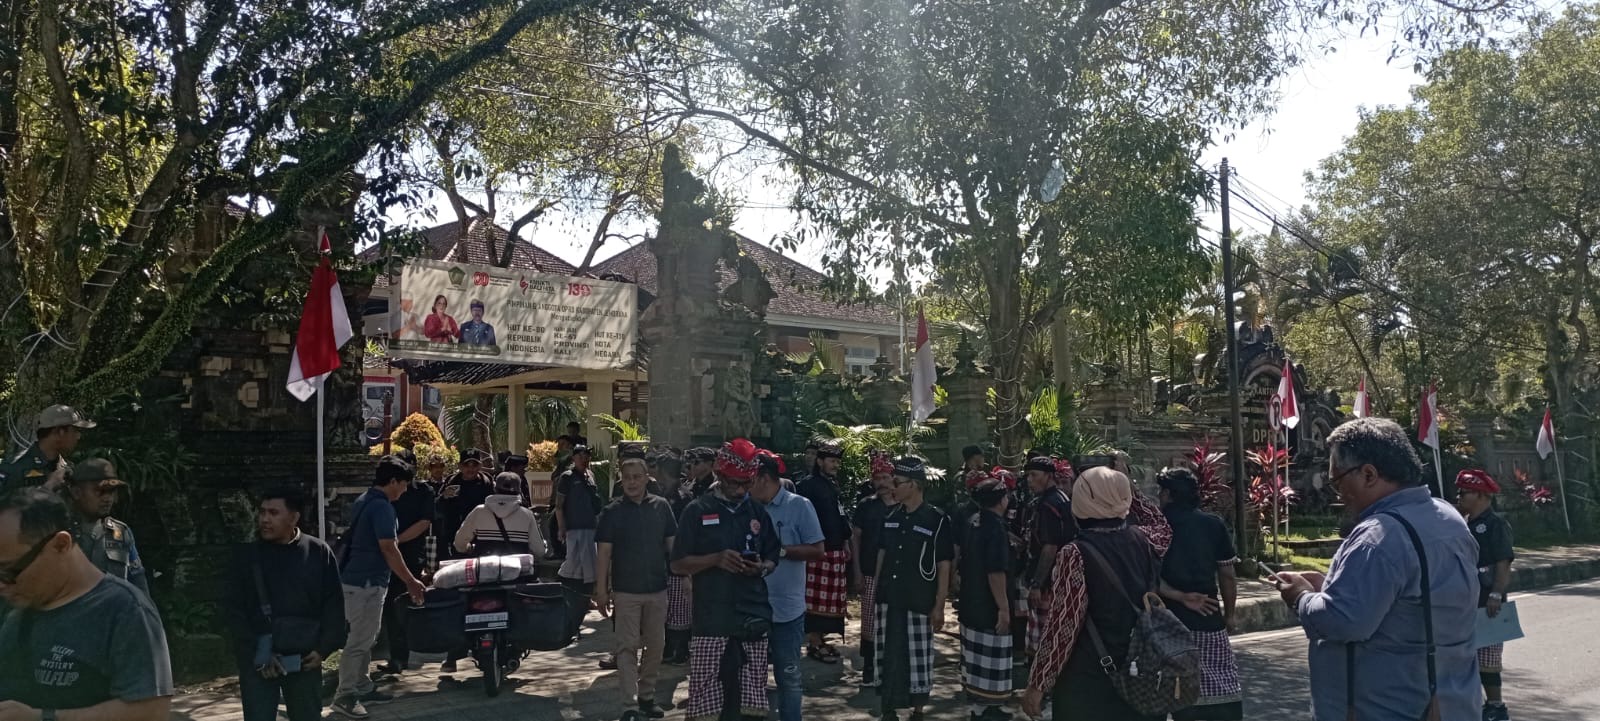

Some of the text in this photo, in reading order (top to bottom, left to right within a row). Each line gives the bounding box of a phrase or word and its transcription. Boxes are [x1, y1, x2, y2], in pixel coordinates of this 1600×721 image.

[506, 324, 519, 333] HUT
[506, 333, 542, 343] REPUBLIK
[594, 330, 605, 339] HUT
[506, 343, 546, 354] INDONESIA
[553, 340, 590, 349] PROVINSI
[594, 340, 612, 349] KOTA
